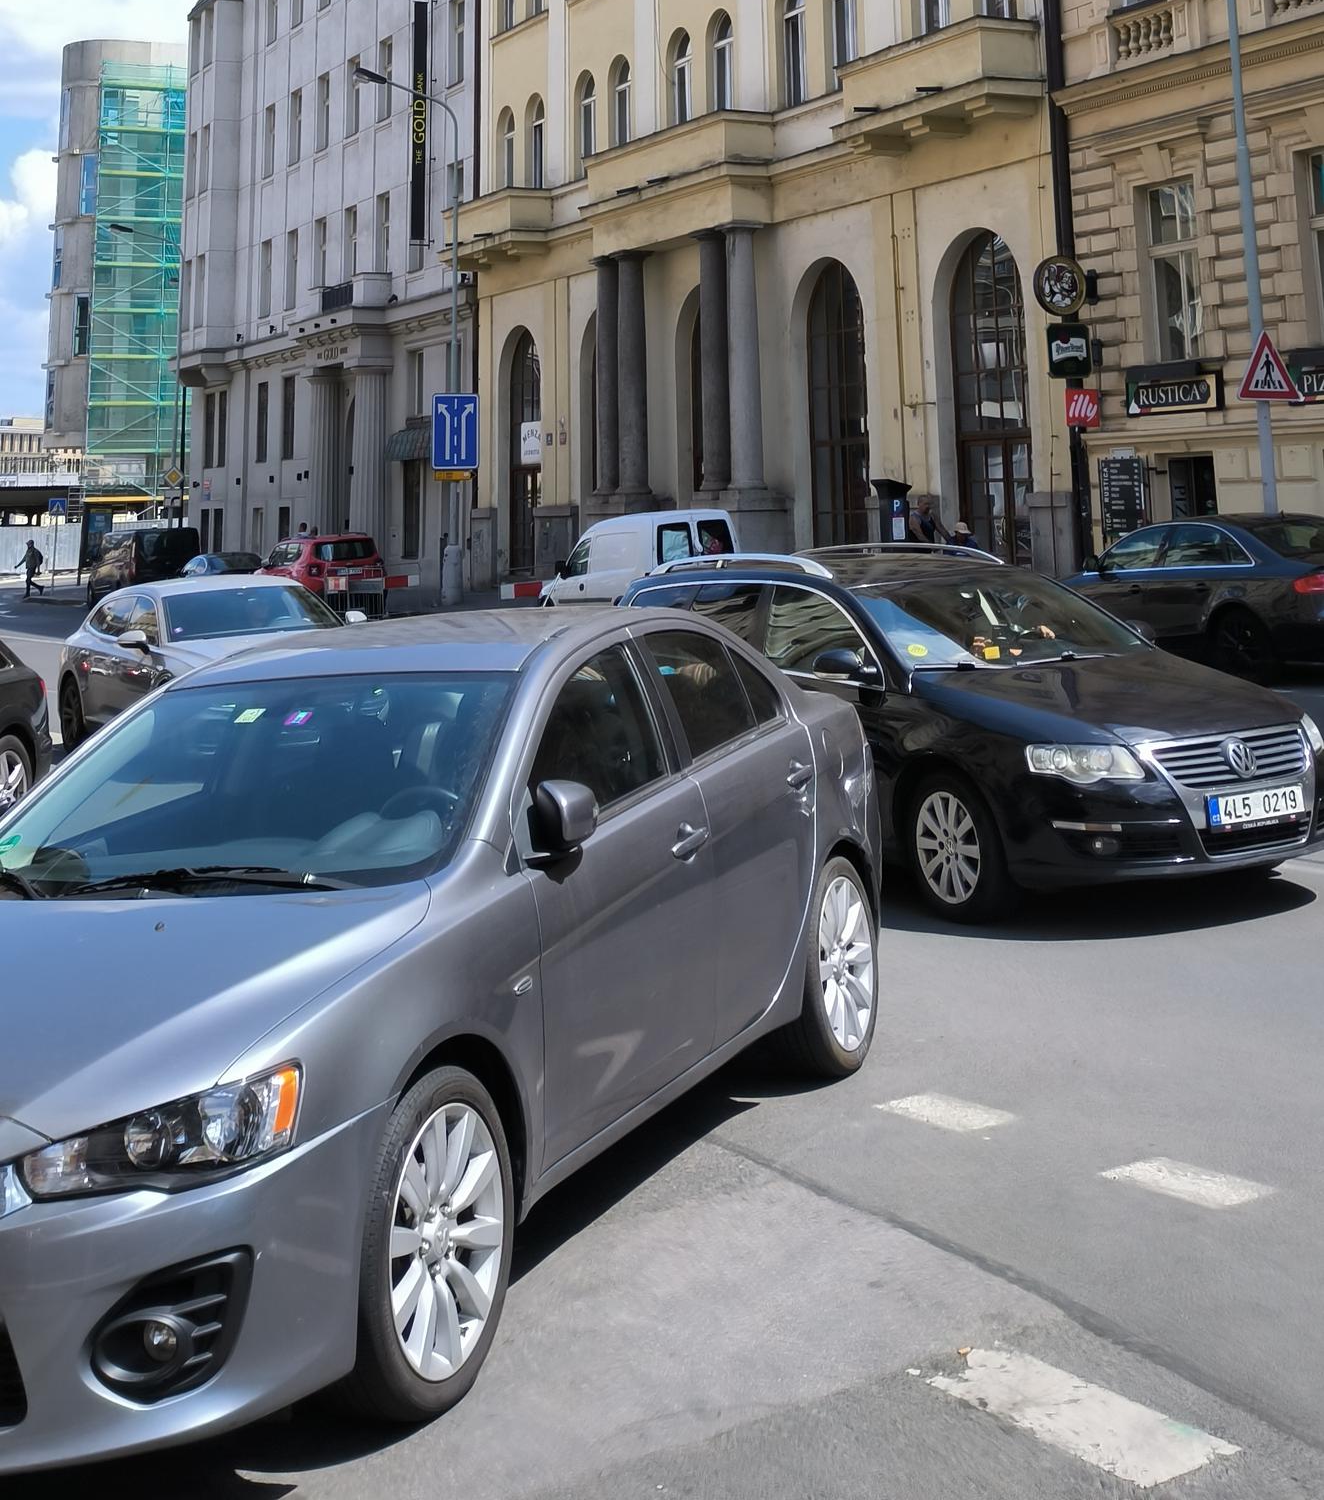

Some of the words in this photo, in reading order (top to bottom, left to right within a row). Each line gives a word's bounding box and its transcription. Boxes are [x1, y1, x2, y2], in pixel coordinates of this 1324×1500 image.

[413, 99, 426, 144] GOLD
[415, 148, 423, 165] THE
[1069, 394, 1098, 422] illy
[893, 499, 901, 512] P
[1224, 796, 1252, 820] 4L5
[1262, 789, 1297, 814] 0219
